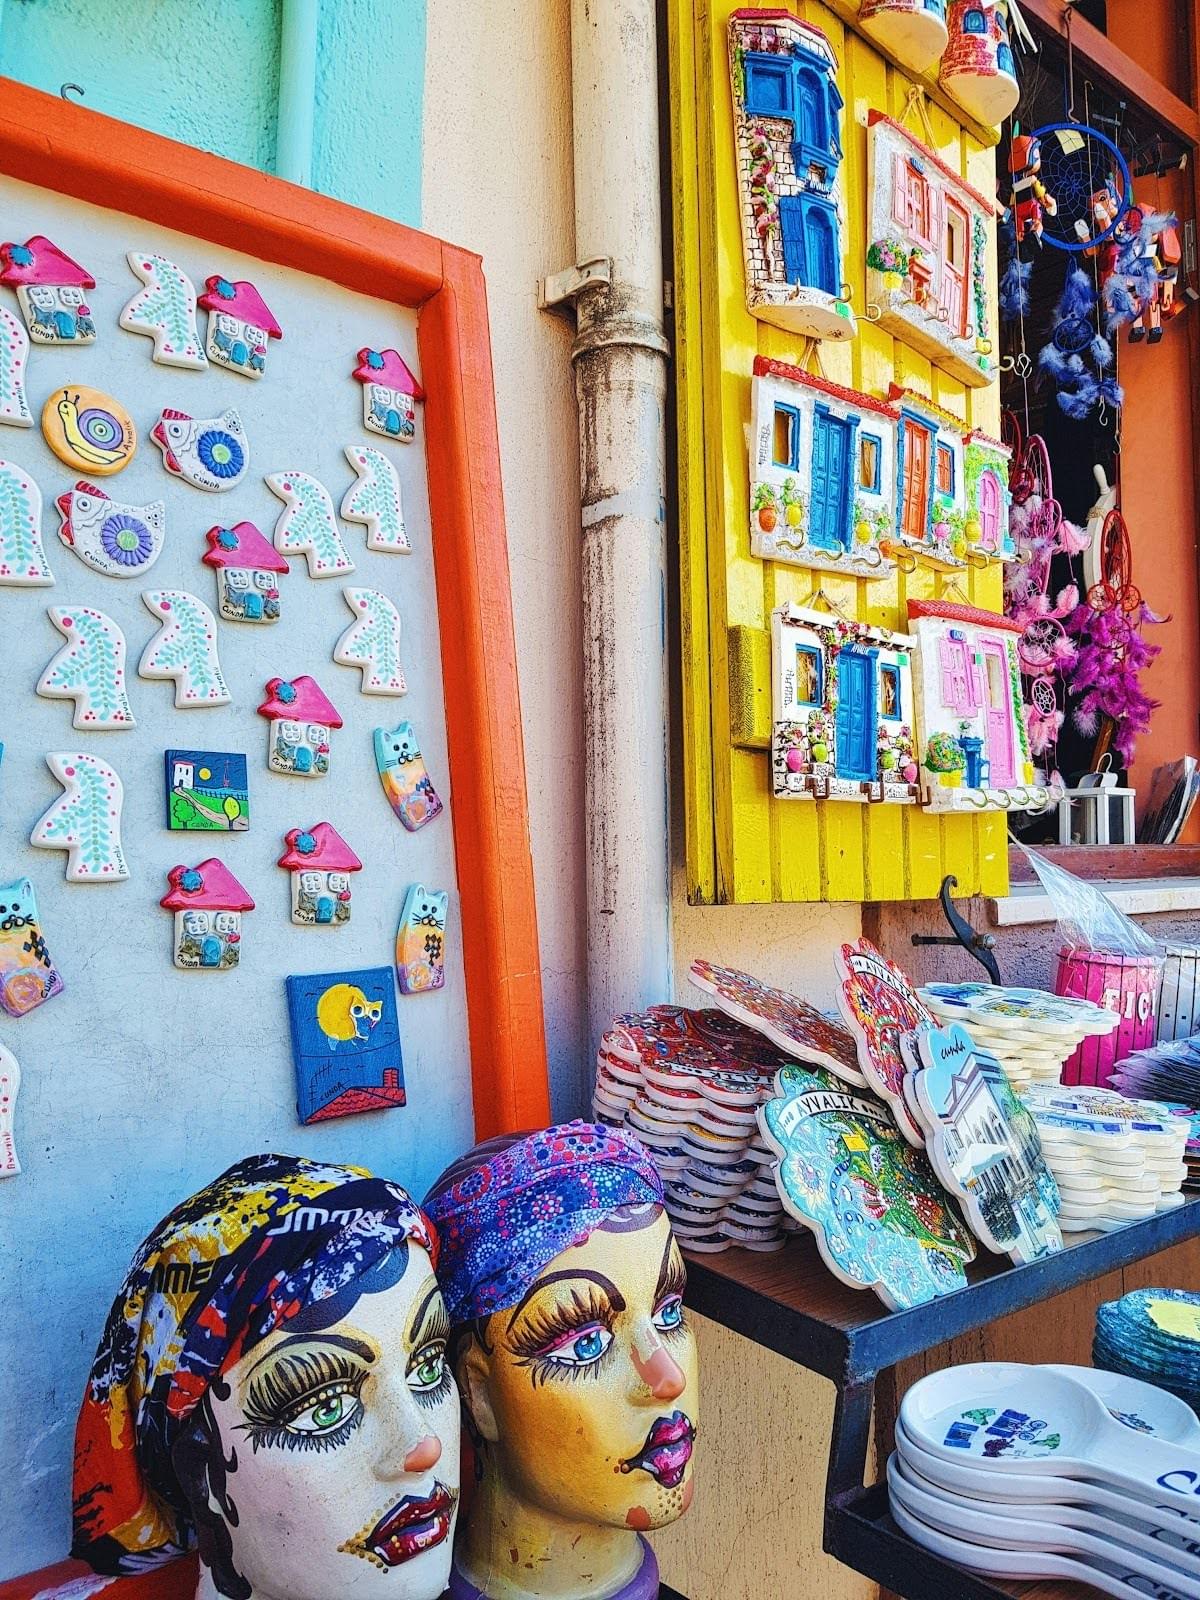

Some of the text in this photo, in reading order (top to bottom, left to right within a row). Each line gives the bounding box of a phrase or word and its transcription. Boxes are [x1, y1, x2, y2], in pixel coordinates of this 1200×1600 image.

[30, 325, 54, 340] CUNDA
[193, 473, 219, 489] CUNDA
[84, 550, 108, 570] CUNDA
[222, 605, 244, 618] CUNDA
[272, 757, 292, 771] CUNDA
[294, 909, 314, 923] CUNDA
[177, 954, 199, 967] CUNDA
[41, 970, 57, 998] CUNDA
[796, 1094, 859, 1117] AYVALIK
